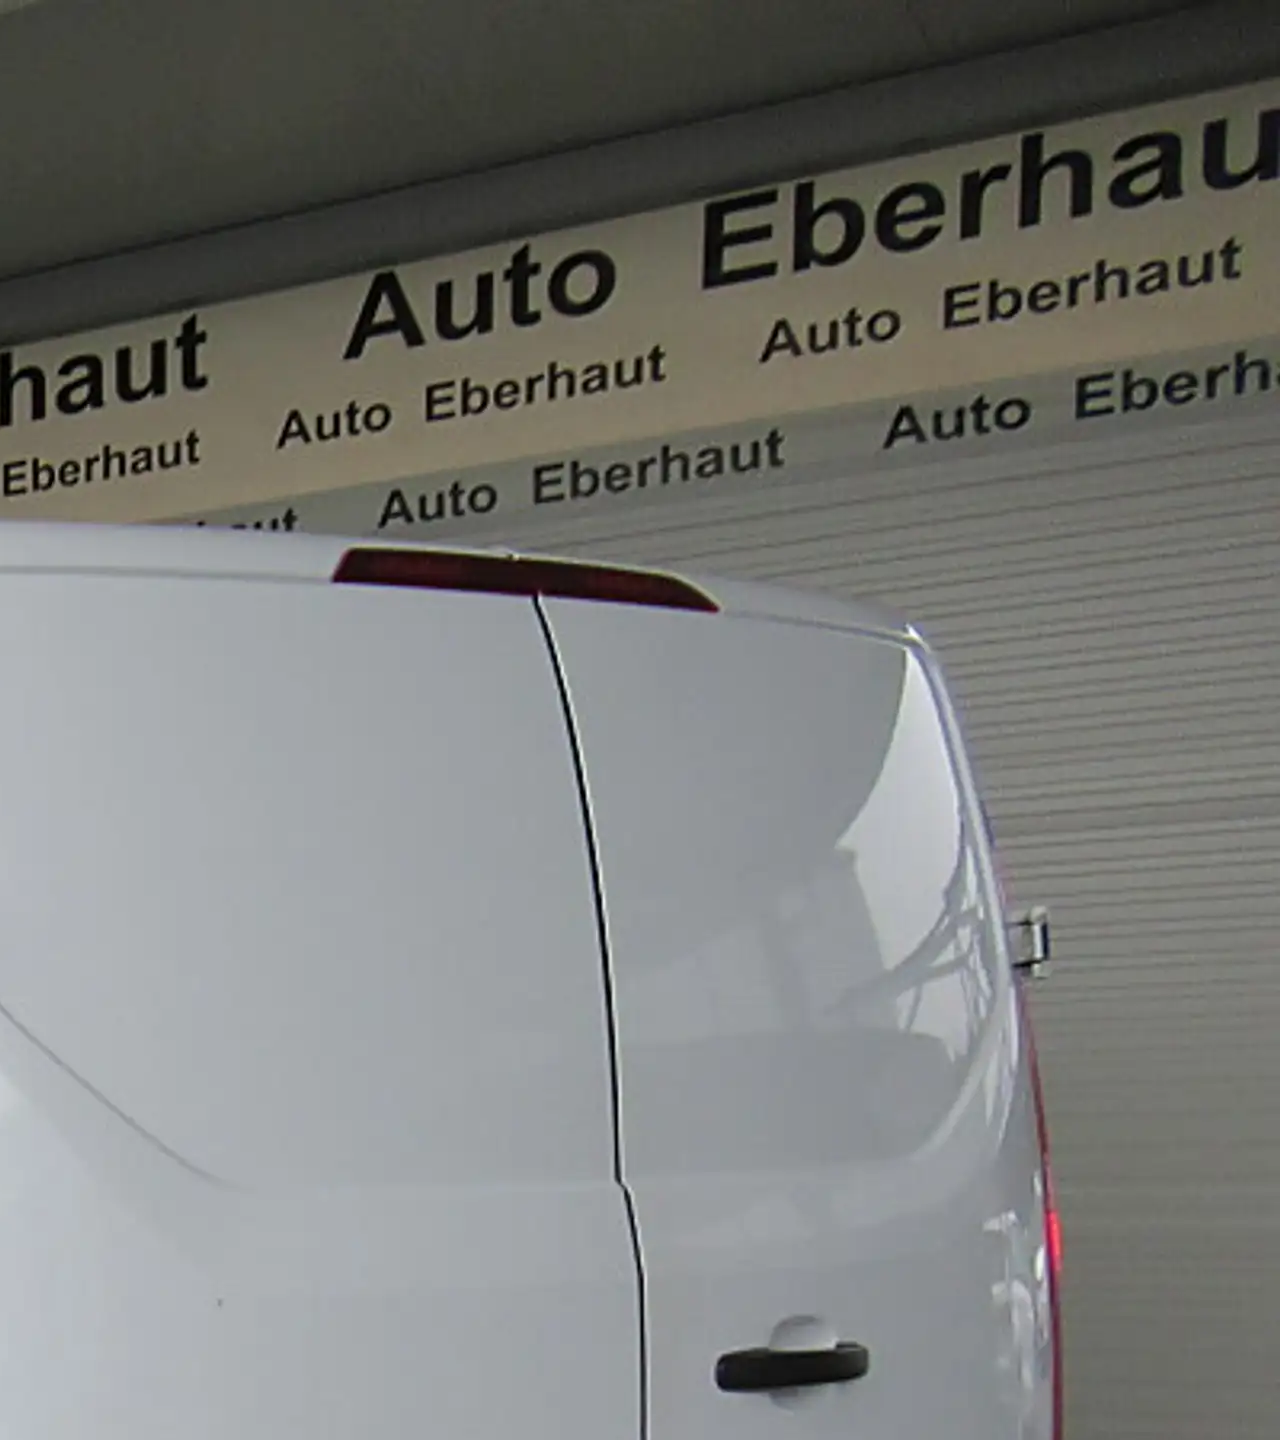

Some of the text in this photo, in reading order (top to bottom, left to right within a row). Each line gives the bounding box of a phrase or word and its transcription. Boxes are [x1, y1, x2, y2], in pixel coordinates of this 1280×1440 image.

[342, 243, 617, 360] Auto
[760, 236, 1243, 363] Auto Eberhaut
[276, 344, 666, 449] Auto Eberhaut
[883, 349, 1280, 449] Auto Eberh
[2, 430, 200, 498] Eberhaut
[378, 429, 785, 528] Auto Eberhaut
